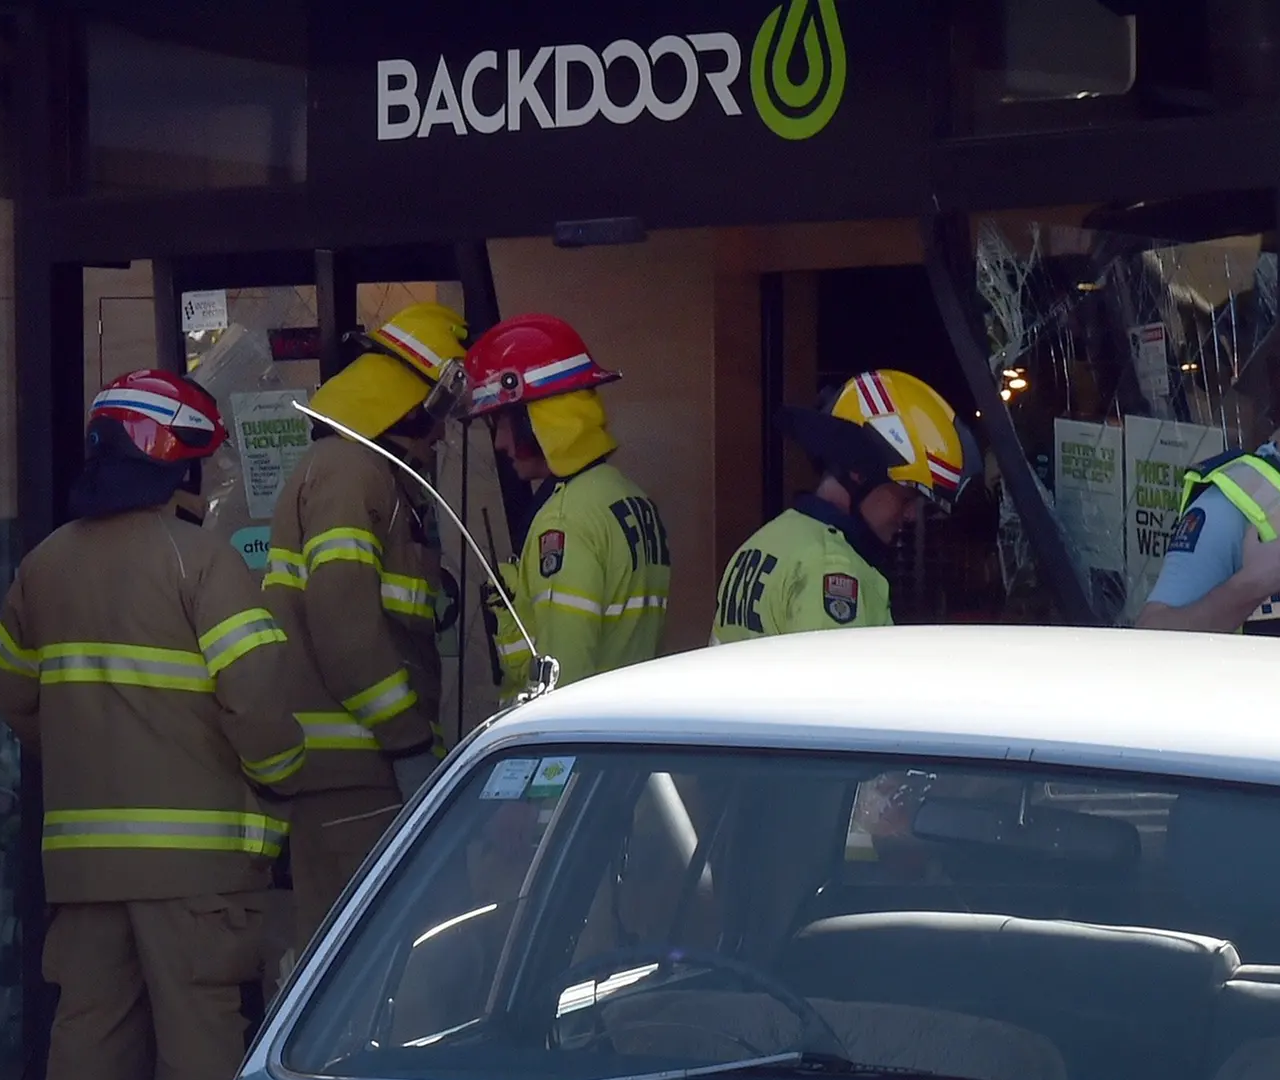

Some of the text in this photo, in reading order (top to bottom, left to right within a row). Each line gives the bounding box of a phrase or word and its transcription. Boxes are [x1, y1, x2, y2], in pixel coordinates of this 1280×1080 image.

[377, 32, 742, 140] BACKDOOR
[1135, 459, 1170, 486] PRICE
[1136, 510, 1163, 529] ON
[1137, 526, 1170, 559] WET
